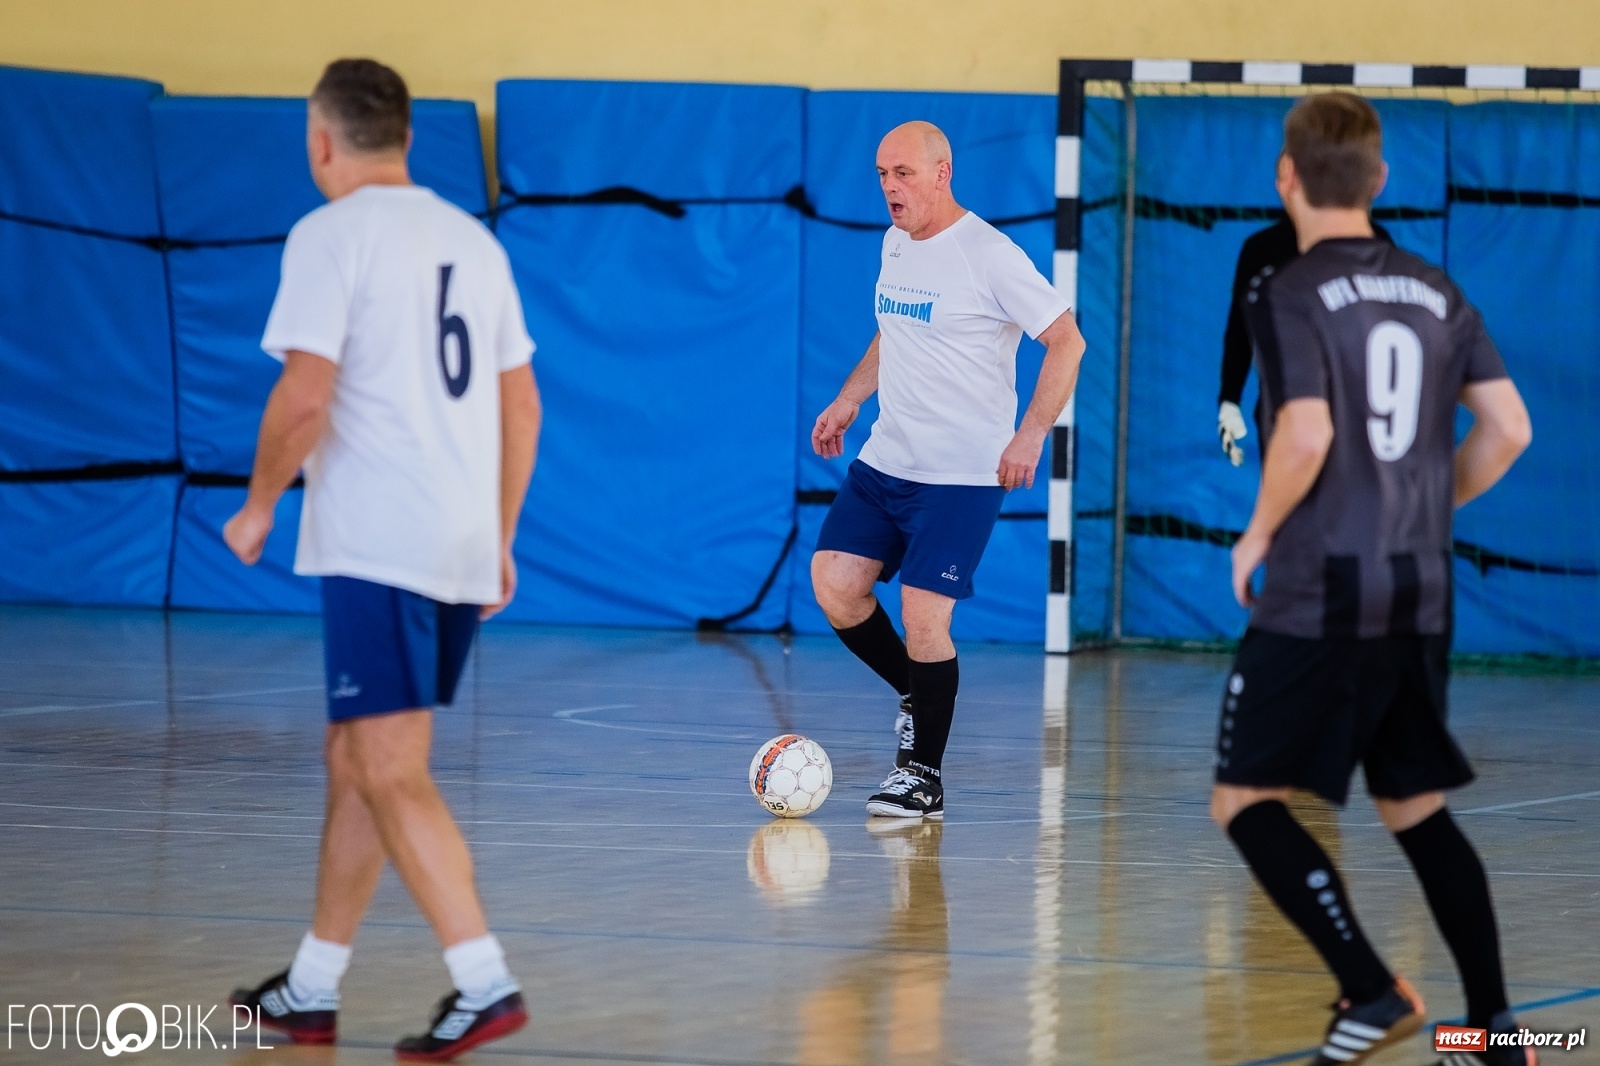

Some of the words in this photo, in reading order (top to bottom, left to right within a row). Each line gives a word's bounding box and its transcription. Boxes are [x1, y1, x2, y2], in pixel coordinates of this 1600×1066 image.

[438, 263, 471, 398] 6
[878, 293, 933, 324] SOLIDUM
[1366, 320, 1423, 462] 9
